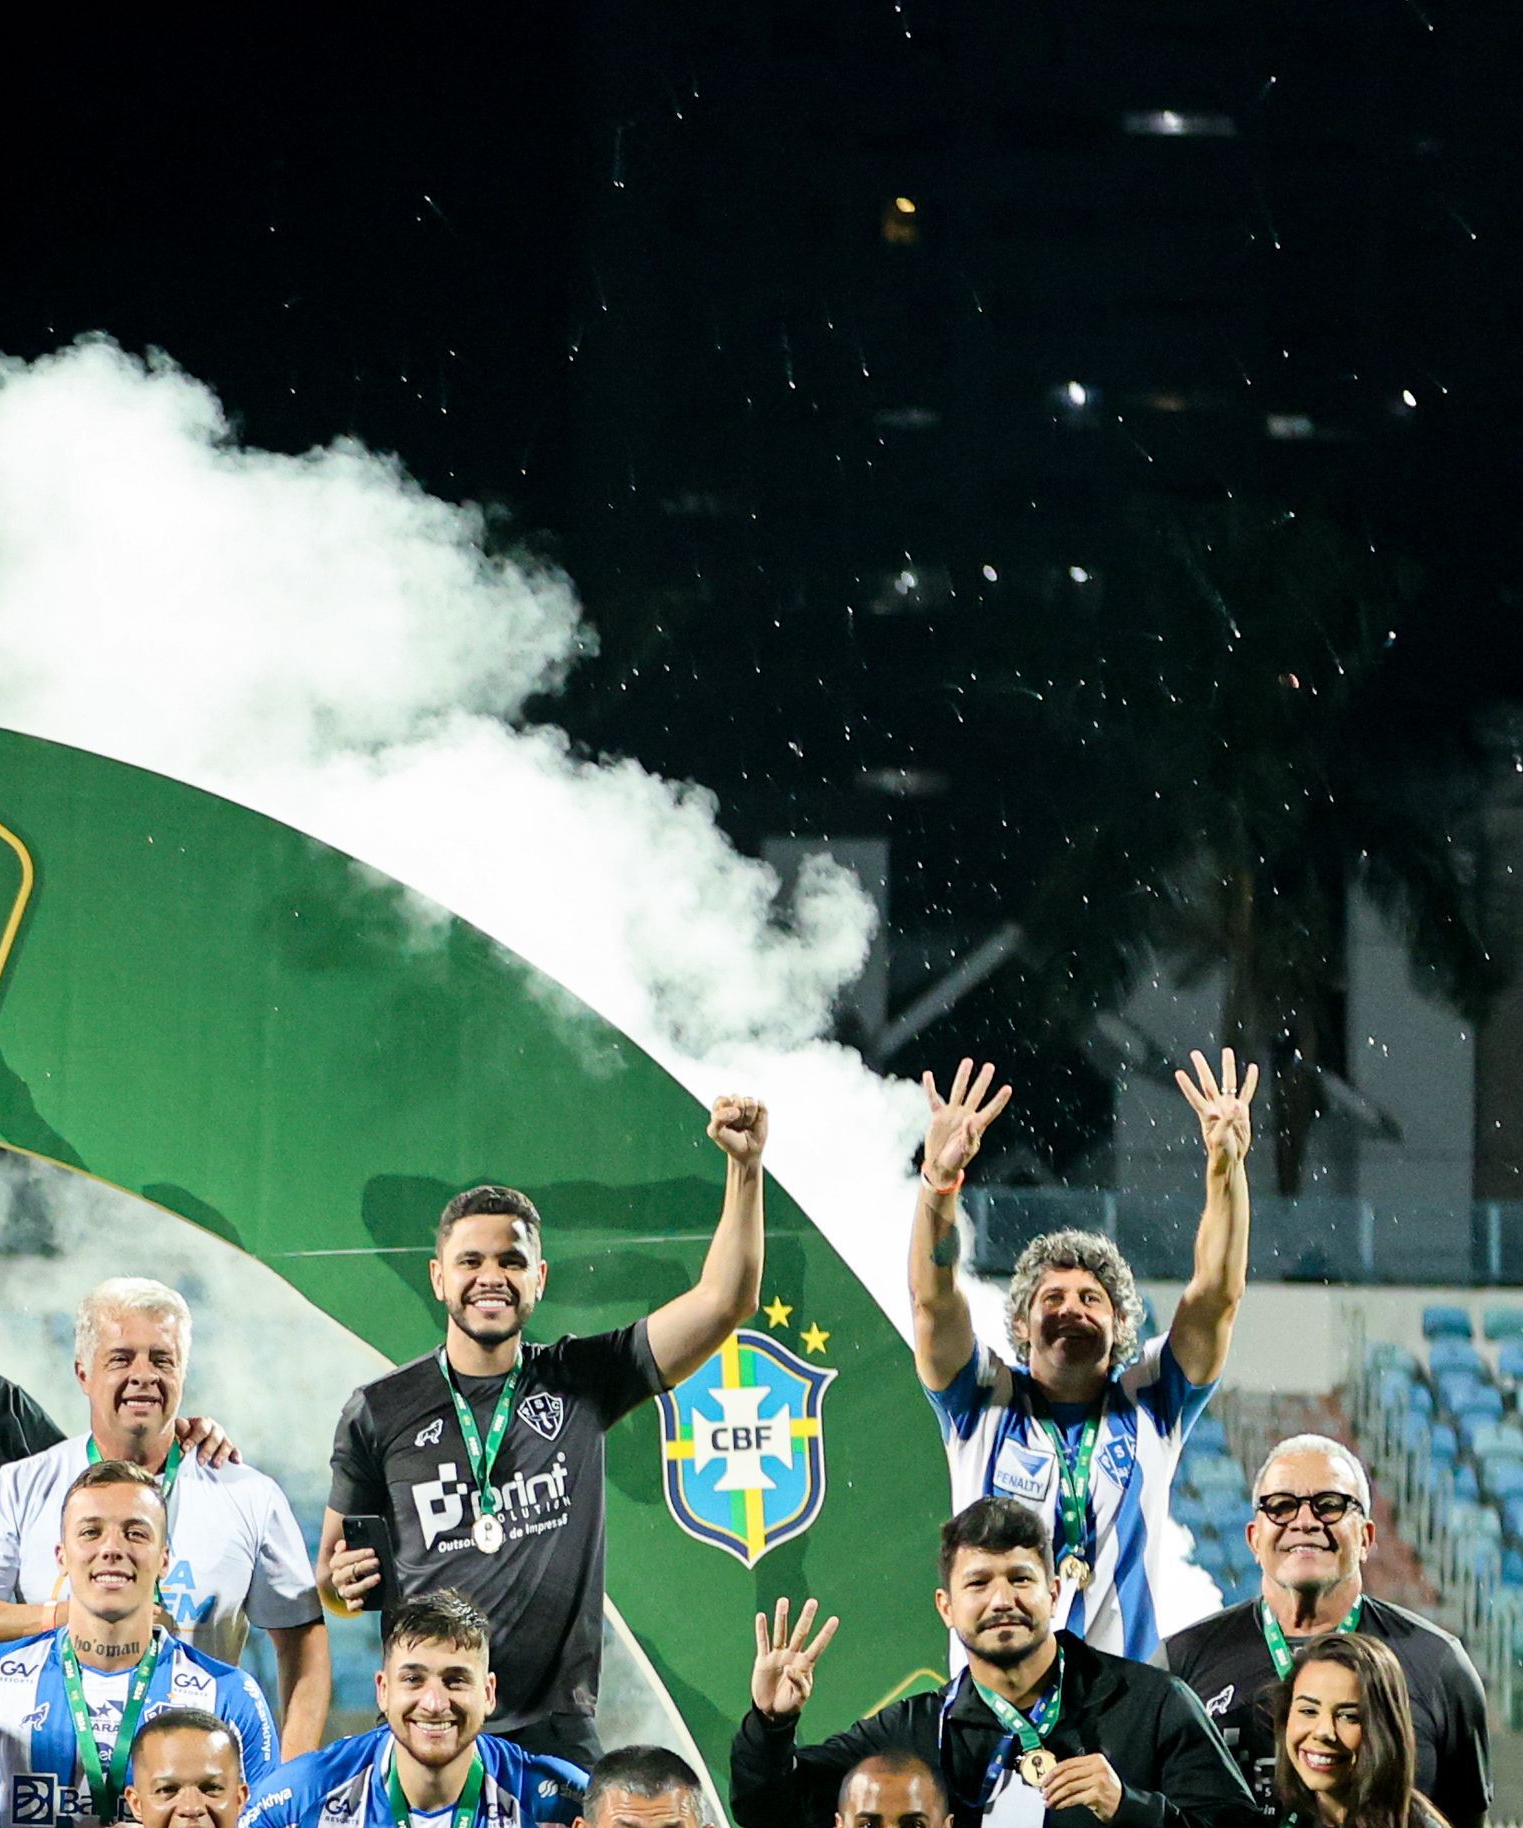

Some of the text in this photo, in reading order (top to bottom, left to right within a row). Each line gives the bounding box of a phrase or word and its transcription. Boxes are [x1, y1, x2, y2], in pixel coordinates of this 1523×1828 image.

[712, 1426, 771, 1451] CBF
[470, 1462, 569, 1522] print
[996, 1470, 1044, 1495] PENALTY
[497, 1496, 573, 1524] OLUTION
[509, 1525, 524, 1540] de
[0, 1660, 39, 1678] GAV
[0, 1677, 35, 1685] RESORTS
[174, 1673, 212, 1691] GAV
[254, 1699, 272, 1763] Sankhya
